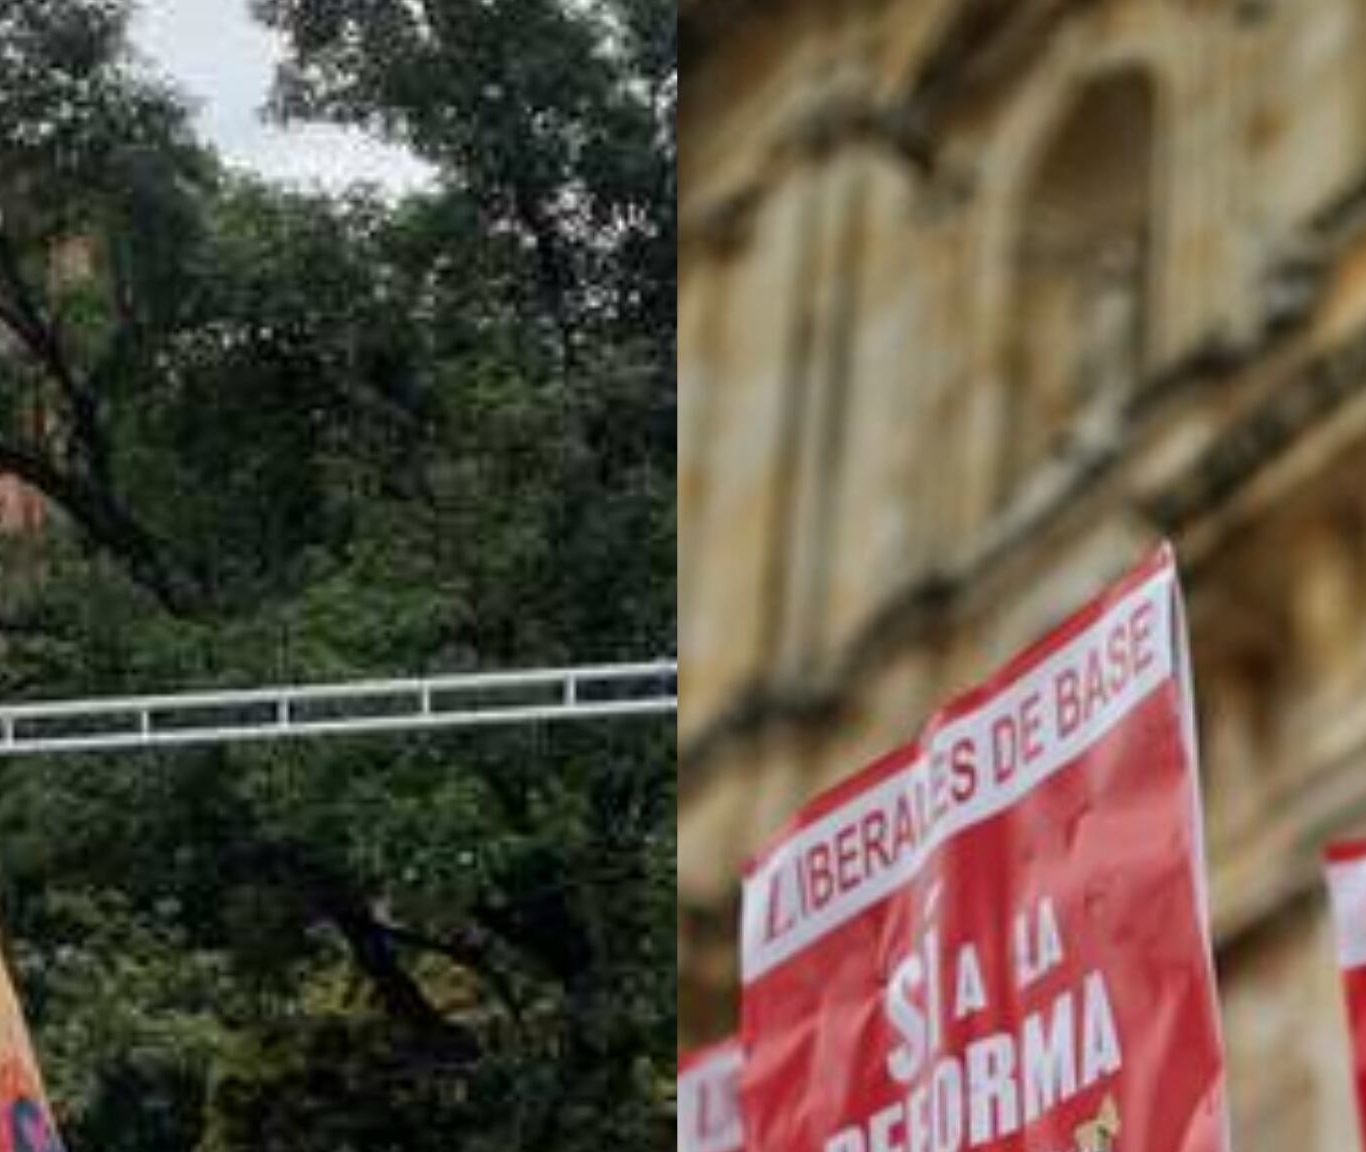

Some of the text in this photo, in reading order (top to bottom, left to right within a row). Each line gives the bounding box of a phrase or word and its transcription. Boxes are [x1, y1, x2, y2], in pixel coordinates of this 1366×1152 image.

[762, 600, 1156, 944] LIBERALES DE BASE
[884, 868, 1064, 1081] SÍ A LA
